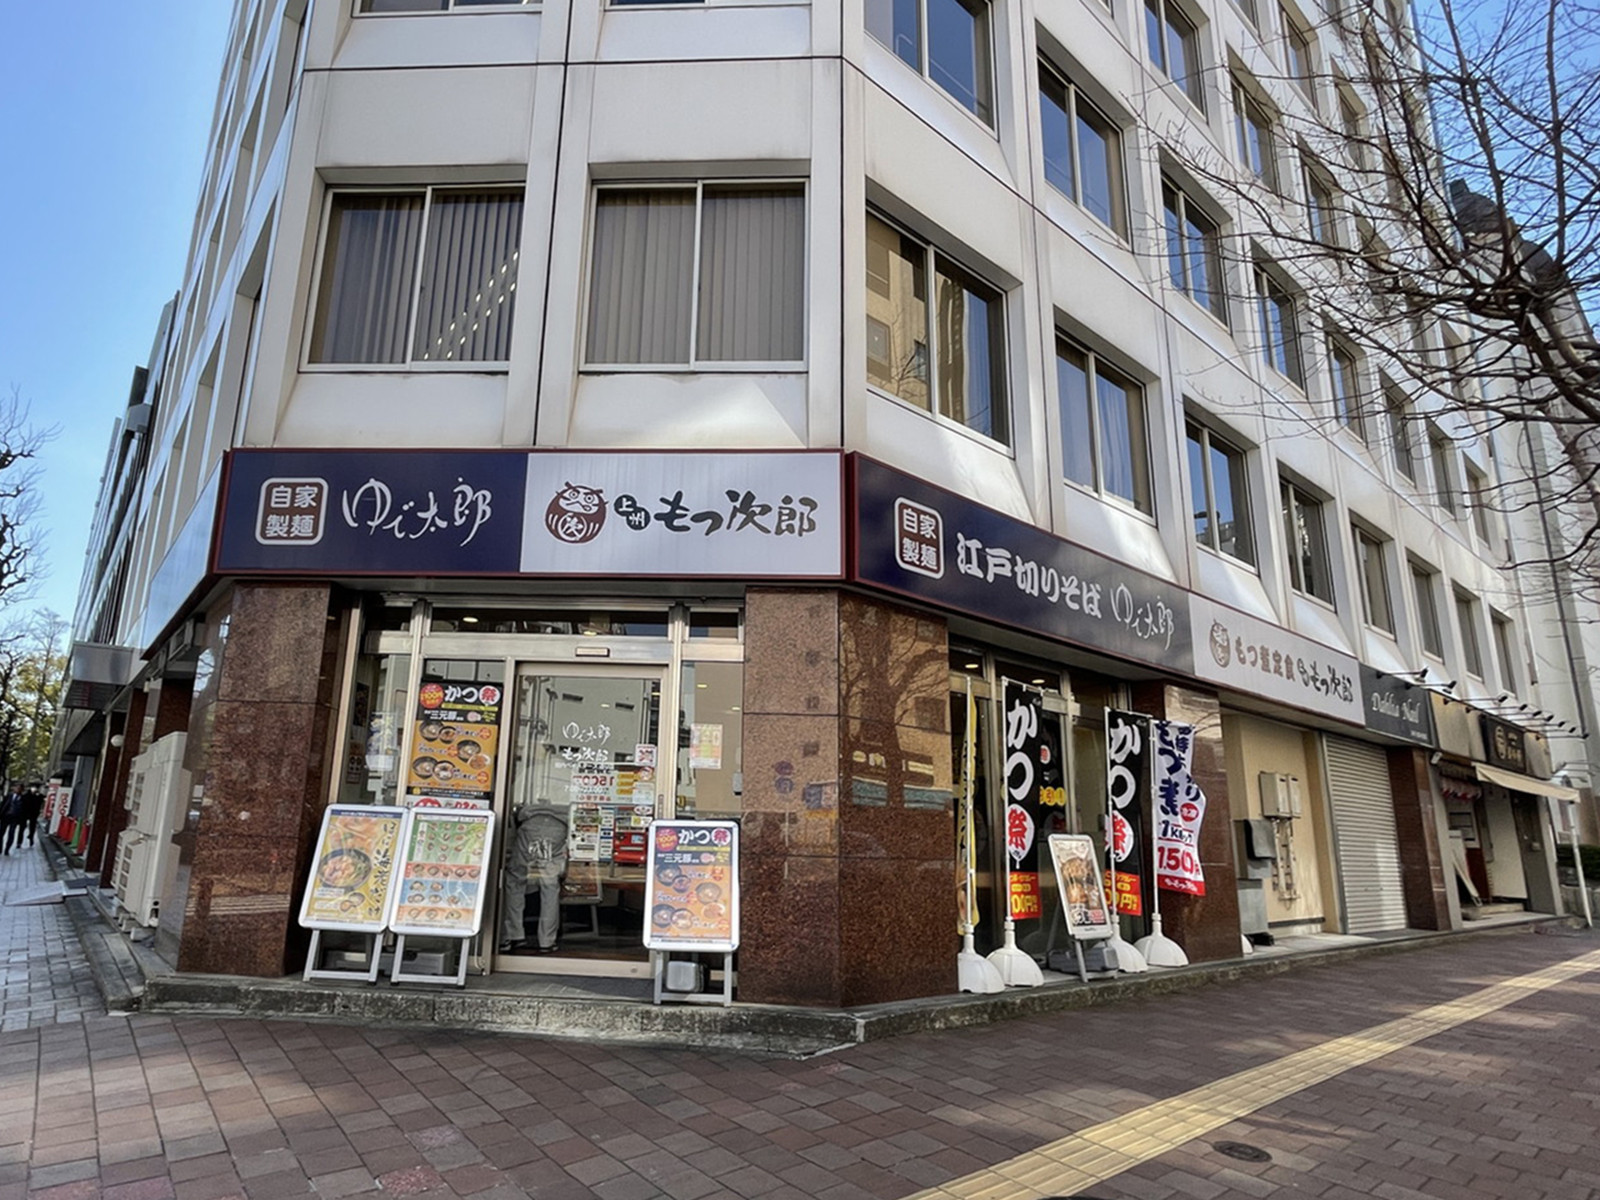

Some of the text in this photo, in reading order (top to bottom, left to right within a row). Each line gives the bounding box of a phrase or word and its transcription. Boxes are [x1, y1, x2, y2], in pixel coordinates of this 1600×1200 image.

[270, 484, 319, 509] 自家
[341, 475, 493, 547] ゆで太郎
[653, 489, 819, 537] もつ次郎
[265, 513, 315, 538] 製麺
[902, 507, 937, 540] 自家
[955, 531, 1175, 651] 江戸切りそば ゆで太郎
